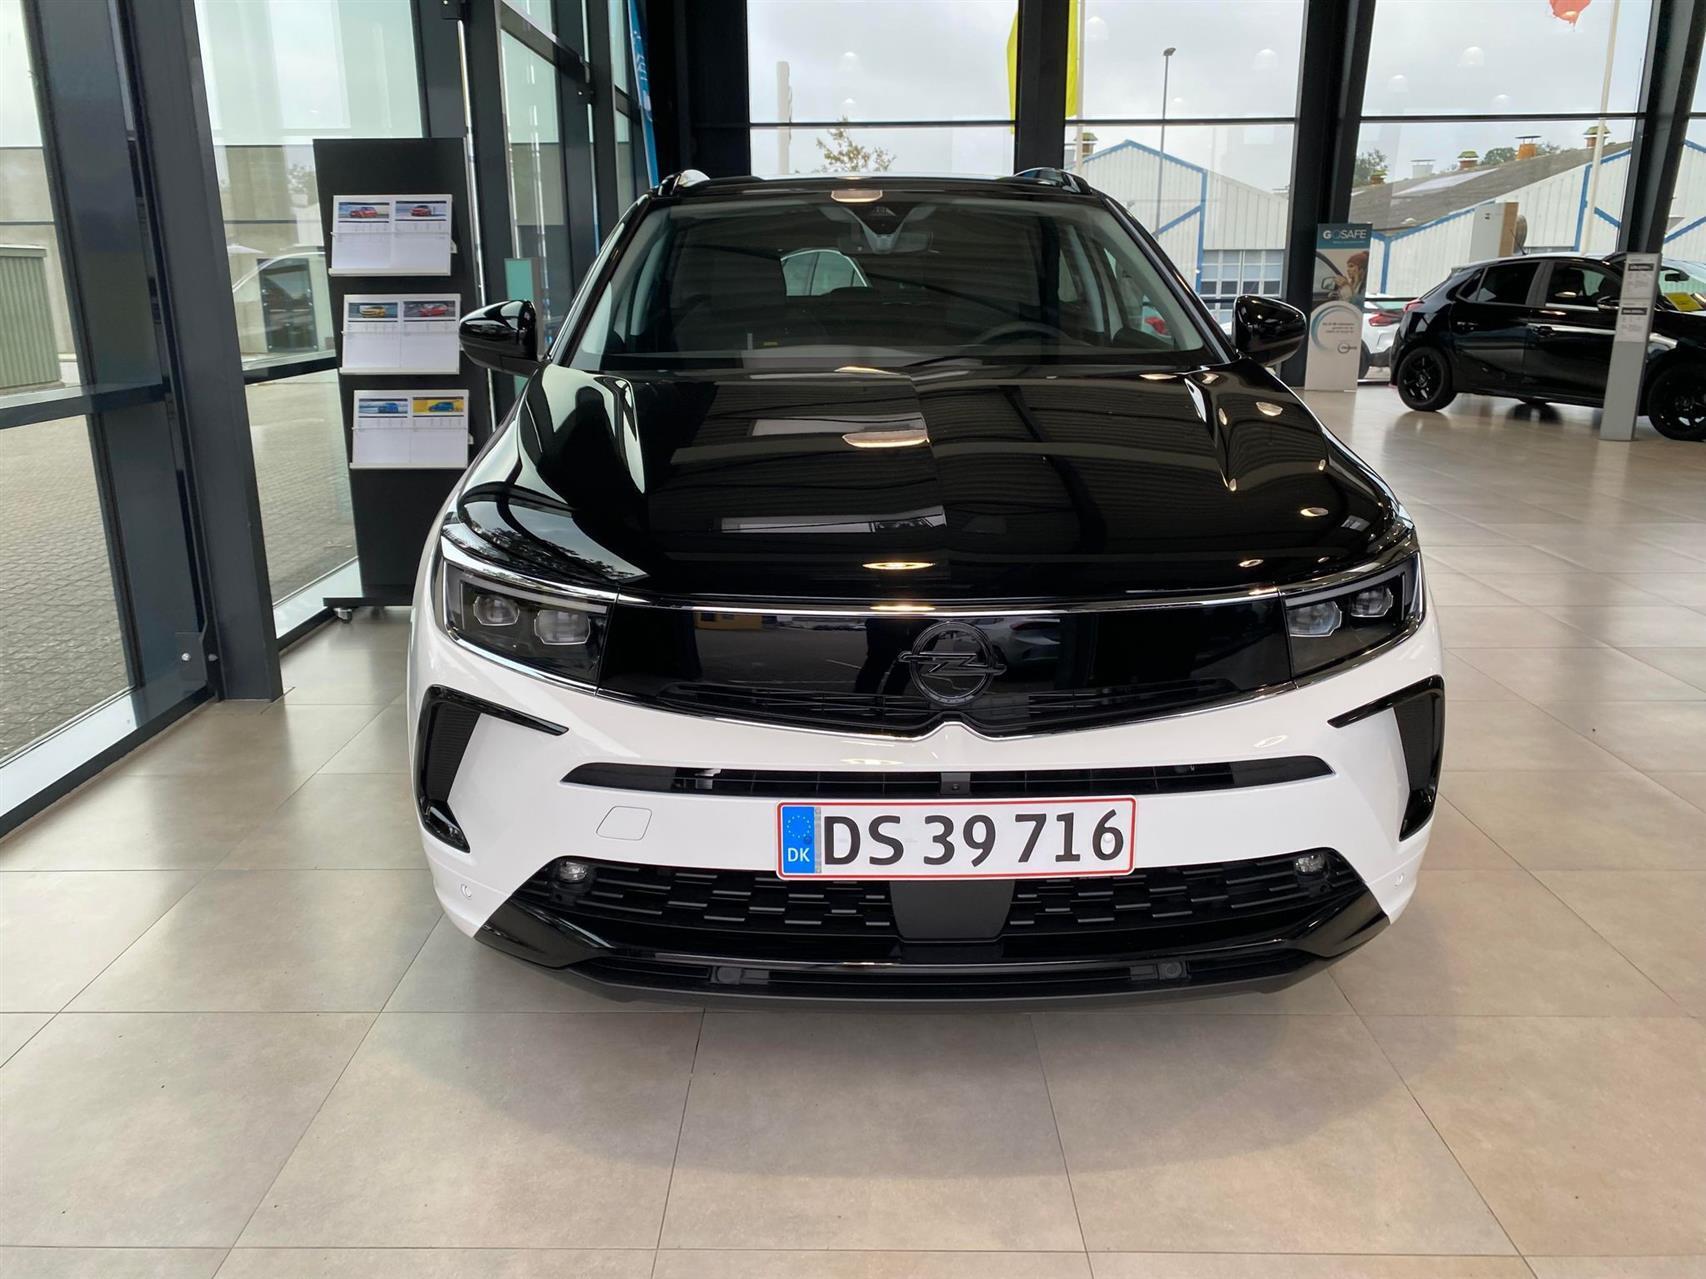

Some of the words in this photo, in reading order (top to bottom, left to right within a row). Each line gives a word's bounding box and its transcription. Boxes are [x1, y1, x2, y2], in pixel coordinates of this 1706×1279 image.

[788, 848, 809, 862] DK
[823, 815, 904, 865] DS
[923, 814, 996, 868] 39
[1014, 808, 1124, 863] 716
